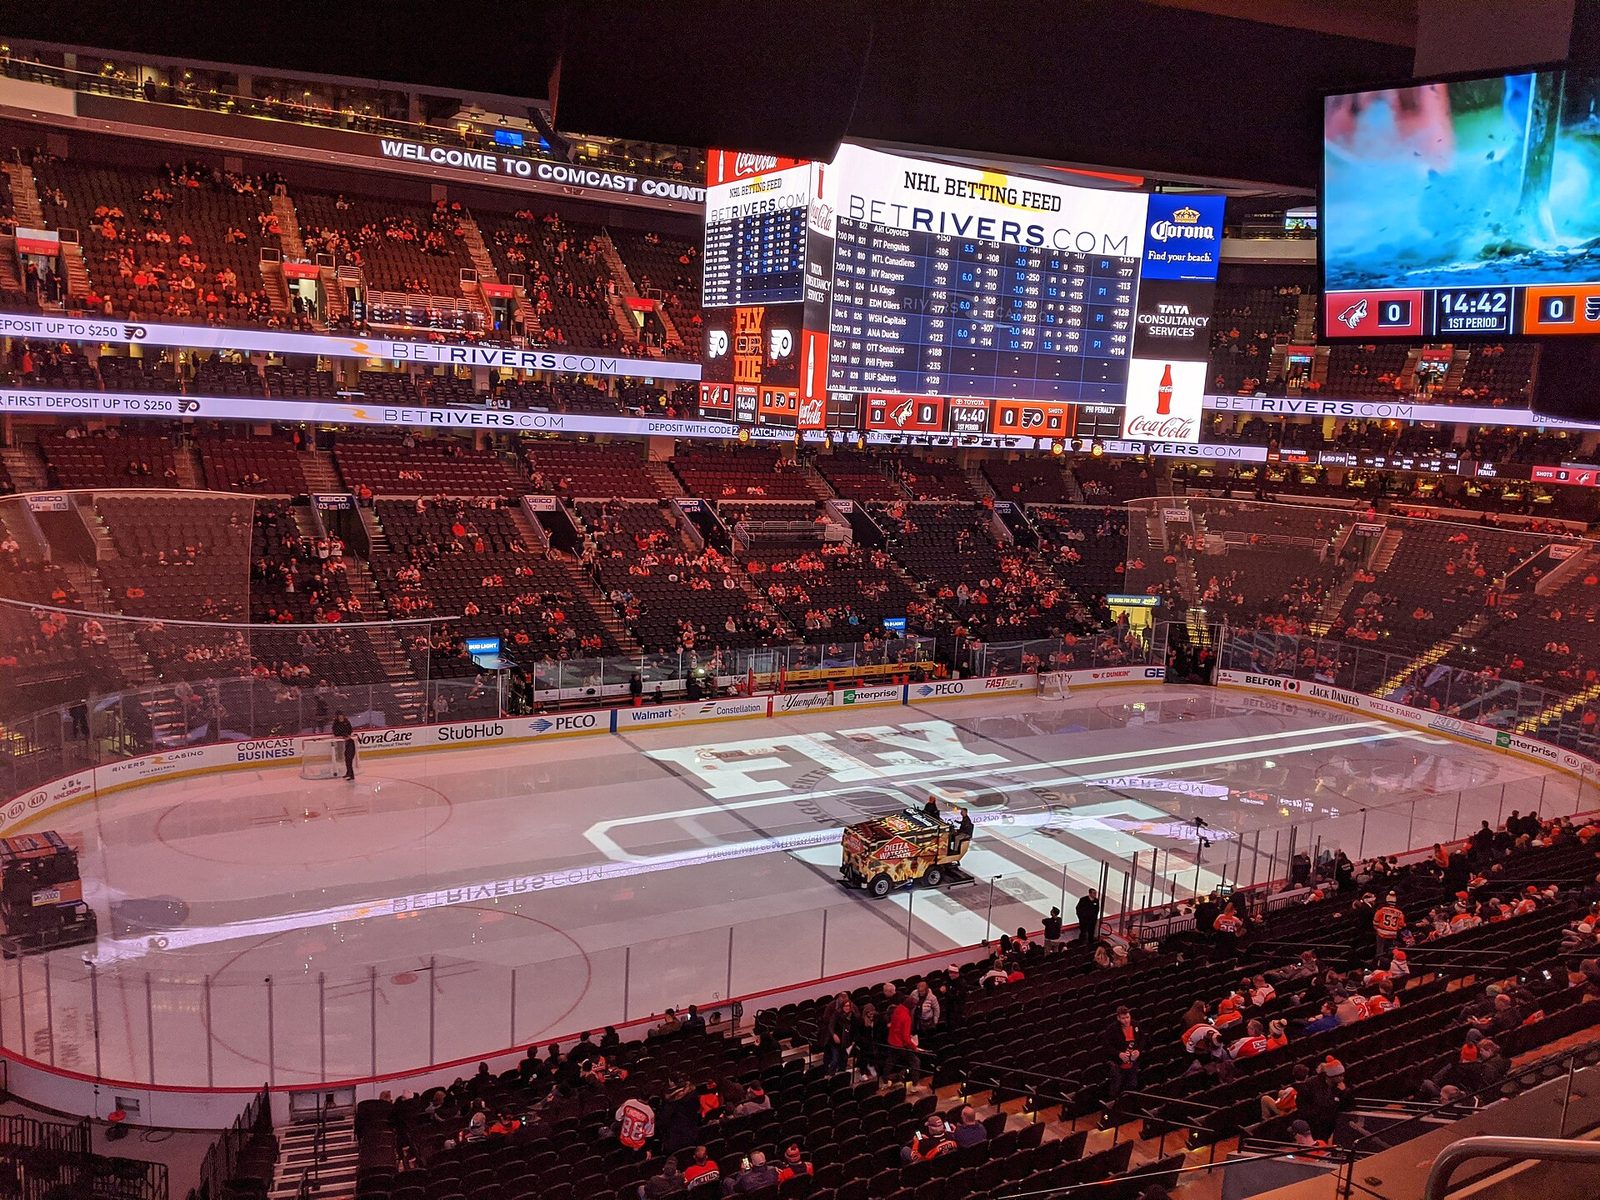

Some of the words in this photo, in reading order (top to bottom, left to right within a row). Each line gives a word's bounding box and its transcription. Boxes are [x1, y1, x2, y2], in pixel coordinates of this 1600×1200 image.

[380, 139, 497, 171] WELCOME
[502, 158, 531, 175] TO
[537, 162, 637, 192] COMCAST
[766, 178, 782, 191] FEED
[904, 171, 940, 193] NHL
[944, 179, 1018, 206] BETTING
[1021, 191, 1062, 212] FEED
[711, 193, 806, 222] BETRIVERS.COM
[850, 194, 1129, 255] BETRIVERS.COM
[1150, 220, 1215, 243] Corona
[883, 240, 910, 252] Penguins
[885, 256, 915, 268] Canadiens
[1148, 251, 1167, 261] Find
[1167, 252, 1187, 262] your
[871, 270, 879, 278] NY
[879, 271, 904, 281] Rangers
[870, 284, 878, 292] LA
[879, 285, 895, 296] Kings
[932, 292, 947, 300] +145
[883, 299, 900, 310] Oilers
[1159, 304, 1189, 315] TATA
[1388, 305, 1400, 321] 0
[1441, 292, 1506, 314] 14:42
[1550, 300, 1563, 318] 0
[735, 307, 764, 334] FLY
[869, 314, 882, 323] WSH
[883, 315, 906, 326] Capitals
[1138, 314, 1209, 327] CONSULTANCY
[1448, 318, 1464, 329] 1ST
[1466, 317, 1497, 328] PERIOD
[46, 323, 64, 334] UP
[68, 325, 85, 335] TO
[88, 324, 118, 337] $250
[867, 329, 880, 337] ANA
[881, 329, 899, 339] Ducks
[1149, 326, 1195, 337] SERVICES
[867, 344, 878, 353] OTT
[879, 345, 904, 354] Senators
[392, 343, 617, 373] BETRIVERS.COM
[866, 358, 877, 367] PHI
[878, 359, 894, 369] Flyers
[734, 355, 762, 383] DIE
[864, 372, 876, 381] BUF
[877, 373, 896, 383] Sabres
[8, 396, 42, 407] FIRST
[46, 397, 100, 409] DEPOSIT
[103, 399, 120, 410] UP
[124, 400, 140, 410] TO
[143, 399, 172, 412] $250
[737, 397, 755, 410] 14:40
[1215, 396, 1413, 419] BETRIVERS.COM
[385, 409, 565, 428] BETRIVERS.COM
[875, 410, 880, 421] 0
[923, 406, 932, 421] 0
[954, 408, 985, 422] 14:40
[1005, 410, 1013, 424] 0
[648, 422, 684, 433] DEPOSIT
[684, 424, 708, 434] WITH
[709, 425, 732, 435] CODE
[1052, 418, 1057, 428] 0
[1128, 415, 1198, 439] Coca-Cola
[1560, 472, 1565, 480] 0
[935, 682, 964, 695] PECO
[1246, 675, 1282, 688] BELFOR
[781, 693, 828, 711] Yuengling
[848, 688, 898, 703] enterprise
[1309, 684, 1329, 699] JACK
[1330, 688, 1360, 707] DANIEL'S
[632, 708, 672, 721] Walmart
[716, 703, 761, 715] Constellation
[1369, 701, 1394, 715] WELLS
[1396, 706, 1422, 721] FARGO
[556, 715, 596, 730] PECO
[356, 730, 412, 745] NovaCare
[438, 722, 504, 741] StubHub
[237, 738, 294, 752] COMCAST
[1500, 737, 1557, 759] enterprise
[112, 760, 145, 772] RIVERS
[168, 750, 204, 761] CASINO
[237, 748, 295, 761] BUSINESS
[31, 794, 44, 806] KIA
[10, 804, 23, 816] KIA
[1384, 914, 1399, 928] 53
